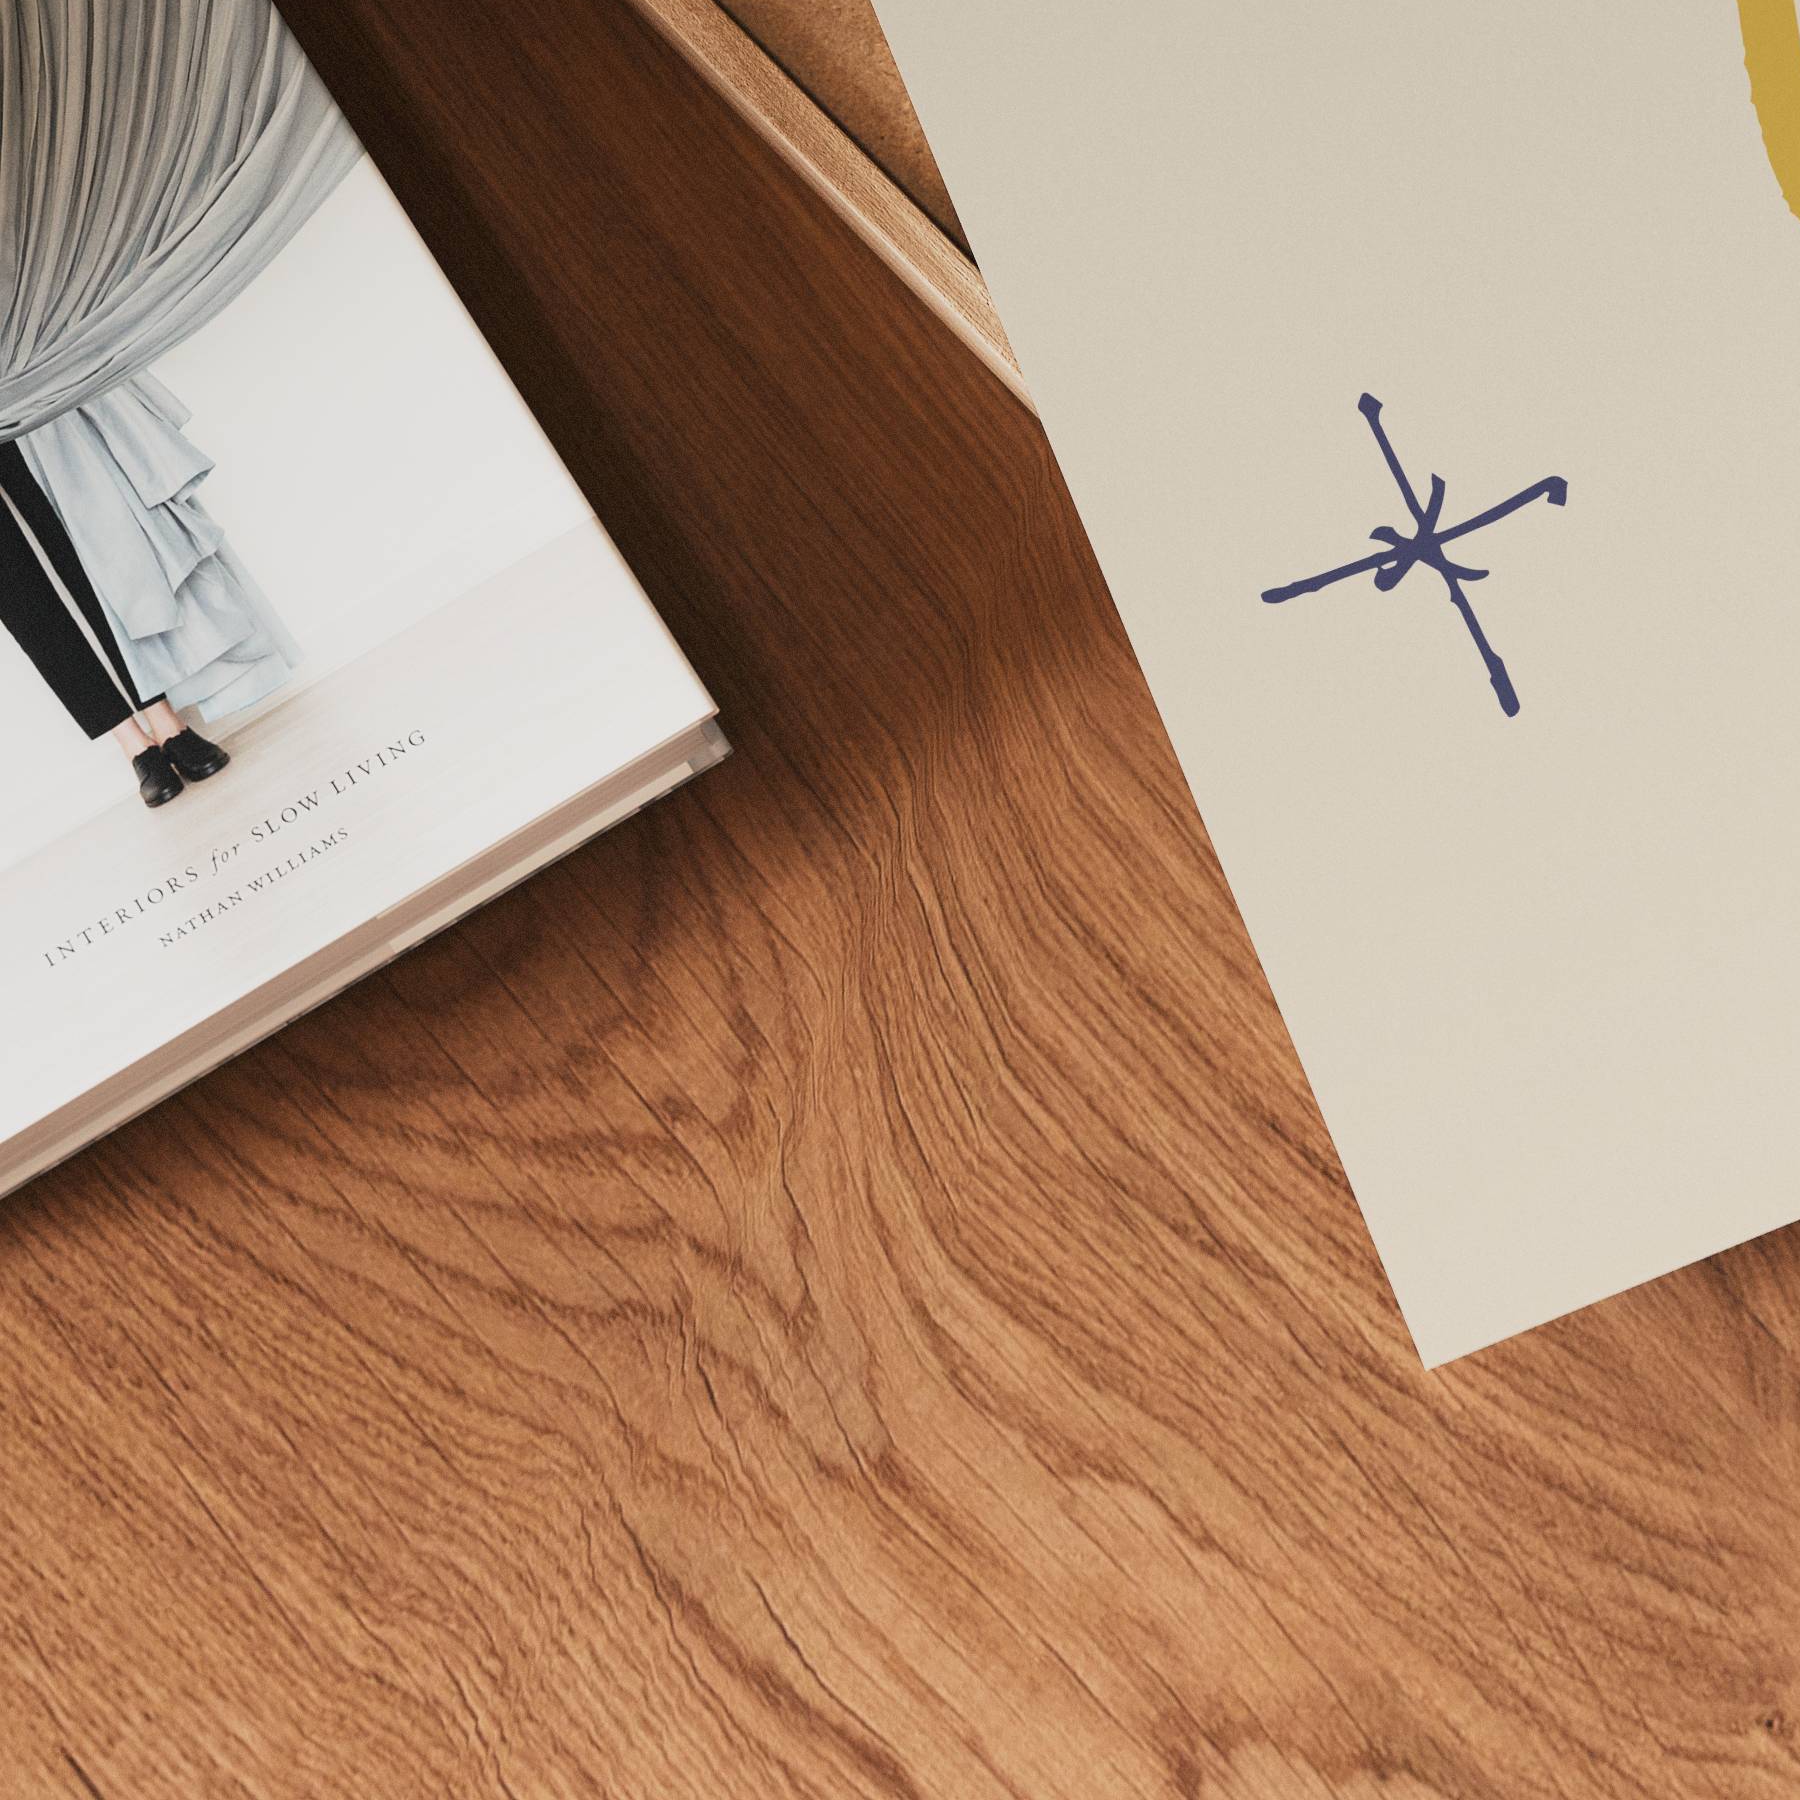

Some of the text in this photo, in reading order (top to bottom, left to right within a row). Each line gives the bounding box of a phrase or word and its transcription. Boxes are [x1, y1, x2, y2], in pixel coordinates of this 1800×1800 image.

[43, 729, 425, 968] INTERIORS for SLOW LIVING
[158, 827, 349, 948] NATHAN WILLIAMS
